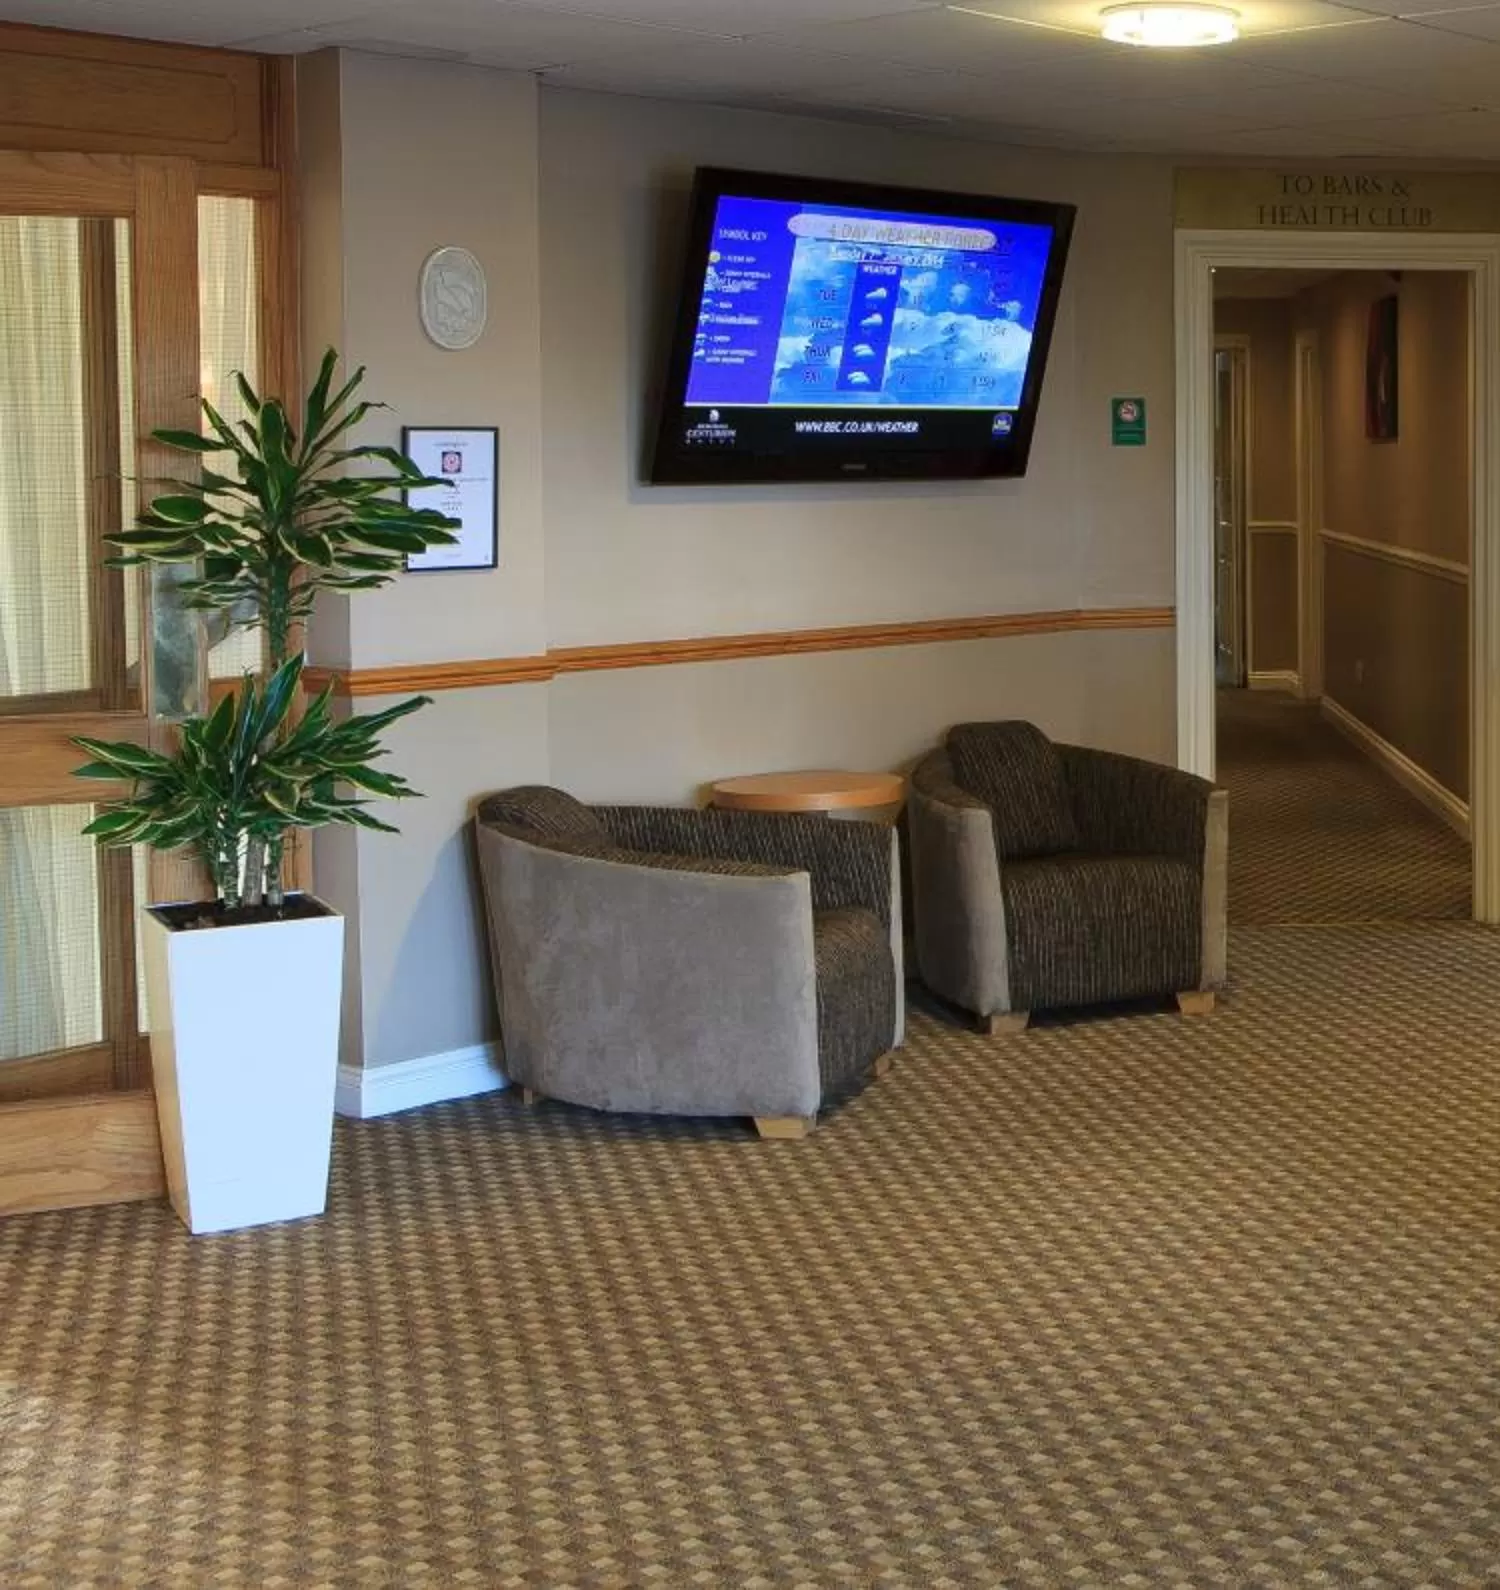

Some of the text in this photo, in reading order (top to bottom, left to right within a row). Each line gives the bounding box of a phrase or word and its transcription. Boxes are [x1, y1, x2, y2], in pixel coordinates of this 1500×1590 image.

[1280, 175, 1409, 198] TO BARS &
[1257, 205, 1433, 226] HEALTH CLUB
[841, 223, 868, 239] DAY
[863, 265, 897, 275] WEATHER
